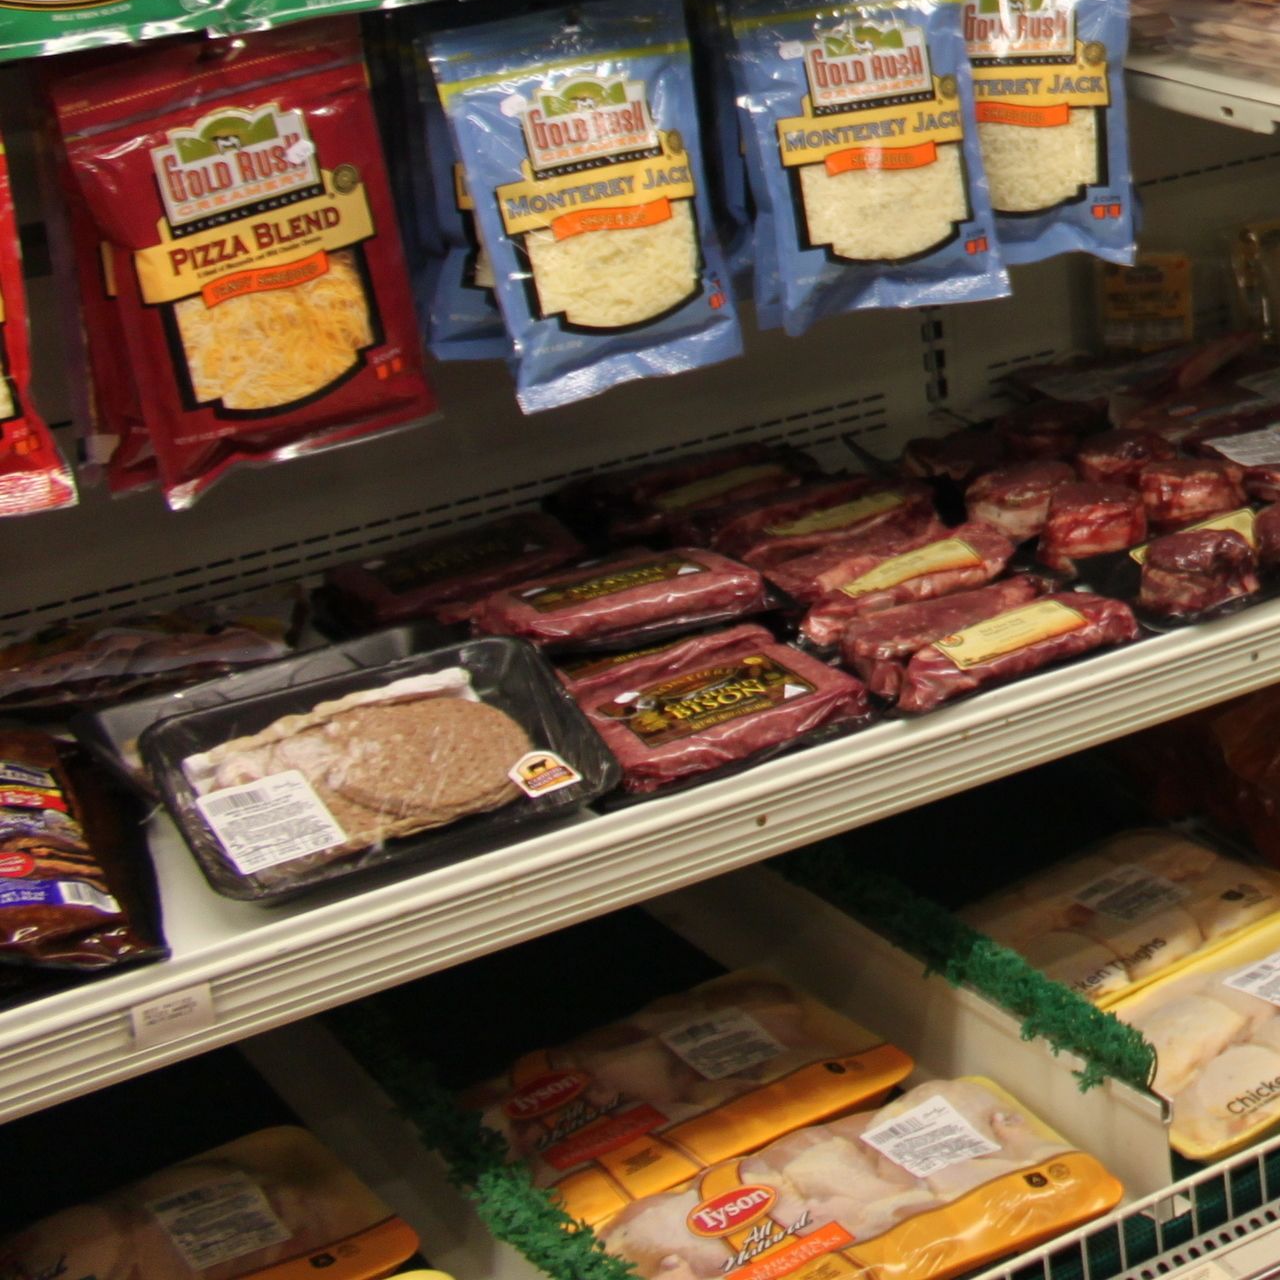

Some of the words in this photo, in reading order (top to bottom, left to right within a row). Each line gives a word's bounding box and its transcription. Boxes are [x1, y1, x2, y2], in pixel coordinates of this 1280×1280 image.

[813, 49, 865, 88] GOLD
[869, 44, 924, 81] RUSH
[1046, 73, 1105, 95] JACK
[530, 111, 588, 158] GOLD
[784, 121, 895, 154] MONTEREY
[163, 150, 234, 205] GOLD
[506, 176, 636, 220] MONTEREY
[641, 164, 691, 191] JACK
[170, 230, 249, 276] PIZZA
[256, 205, 342, 251] BLEND
[664, 679, 767, 719] BISON
[512, 1074, 582, 1112] Tyson
[692, 1186, 771, 1228] Tyson
[720, 1210, 813, 1271] Natural
[744, 1219, 774, 1248] All
